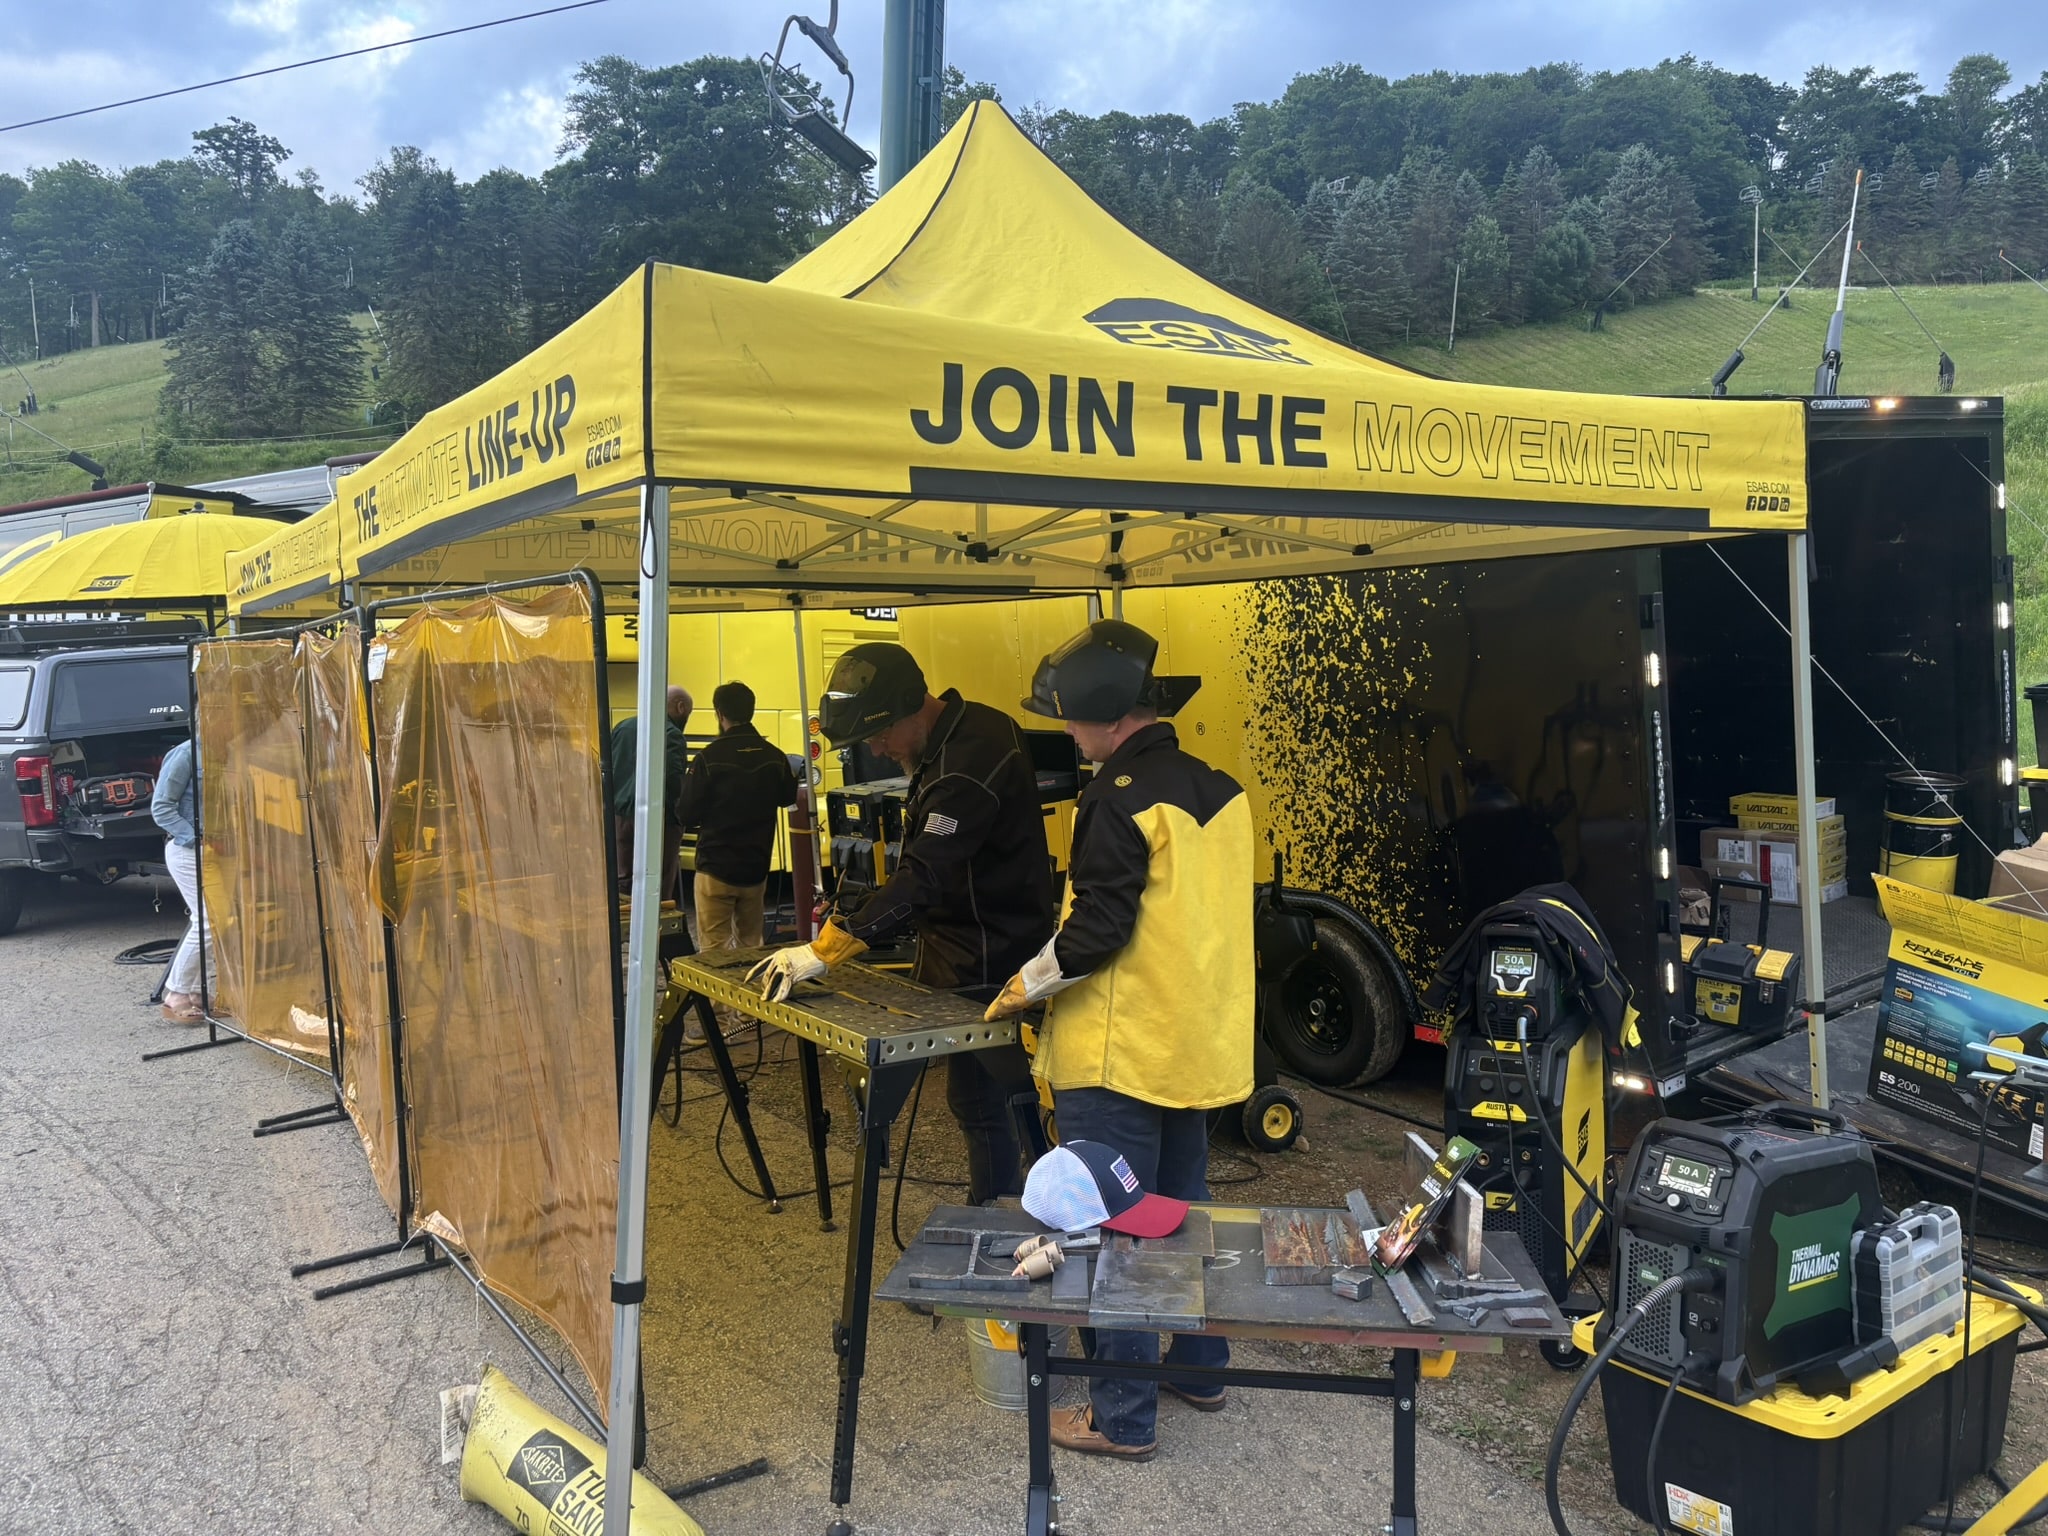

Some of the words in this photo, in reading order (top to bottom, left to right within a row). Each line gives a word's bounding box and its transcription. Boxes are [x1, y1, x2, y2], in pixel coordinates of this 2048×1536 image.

[587, 414, 623, 443] ESAB.COM
[910, 362, 1136, 458] JOIN
[1167, 385, 1328, 468] THE
[1354, 401, 1711, 491] MOVEMENT
[354, 485, 380, 544] THE
[379, 432, 462, 532] ULTIMATE
[464, 374, 577, 491] LINE-UP
[1746, 481, 1791, 495] ESAB.COM
[255, 549, 271, 588] THE
[90, 579, 124, 589] ESAB
[1747, 804, 1788, 815] VACPAC
[1758, 821, 1800, 832] VACPAC
[1886, 884, 1900, 893] ES
[1504, 955, 1524, 966] 50A
[1903, 940, 1985, 971] RENEGADE
[1952, 966, 1979, 979] VOLT
[1879, 1070, 1896, 1085] ES
[1897, 1078, 1921, 1095] 200i
[1486, 1103, 1514, 1112] RUSTLR
[1577, 1125, 1589, 1151] ESAB
[1678, 1165, 1691, 1175] 50
[1691, 1169, 1699, 1178] A
[1791, 1243, 1822, 1264] THERMAL
[1788, 1251, 1840, 1285] DYNAMICS
[523, 1446, 566, 1483] SAKRETE
[1668, 1486, 1690, 1502] HDX
[515, 1505, 530, 1531] 70
